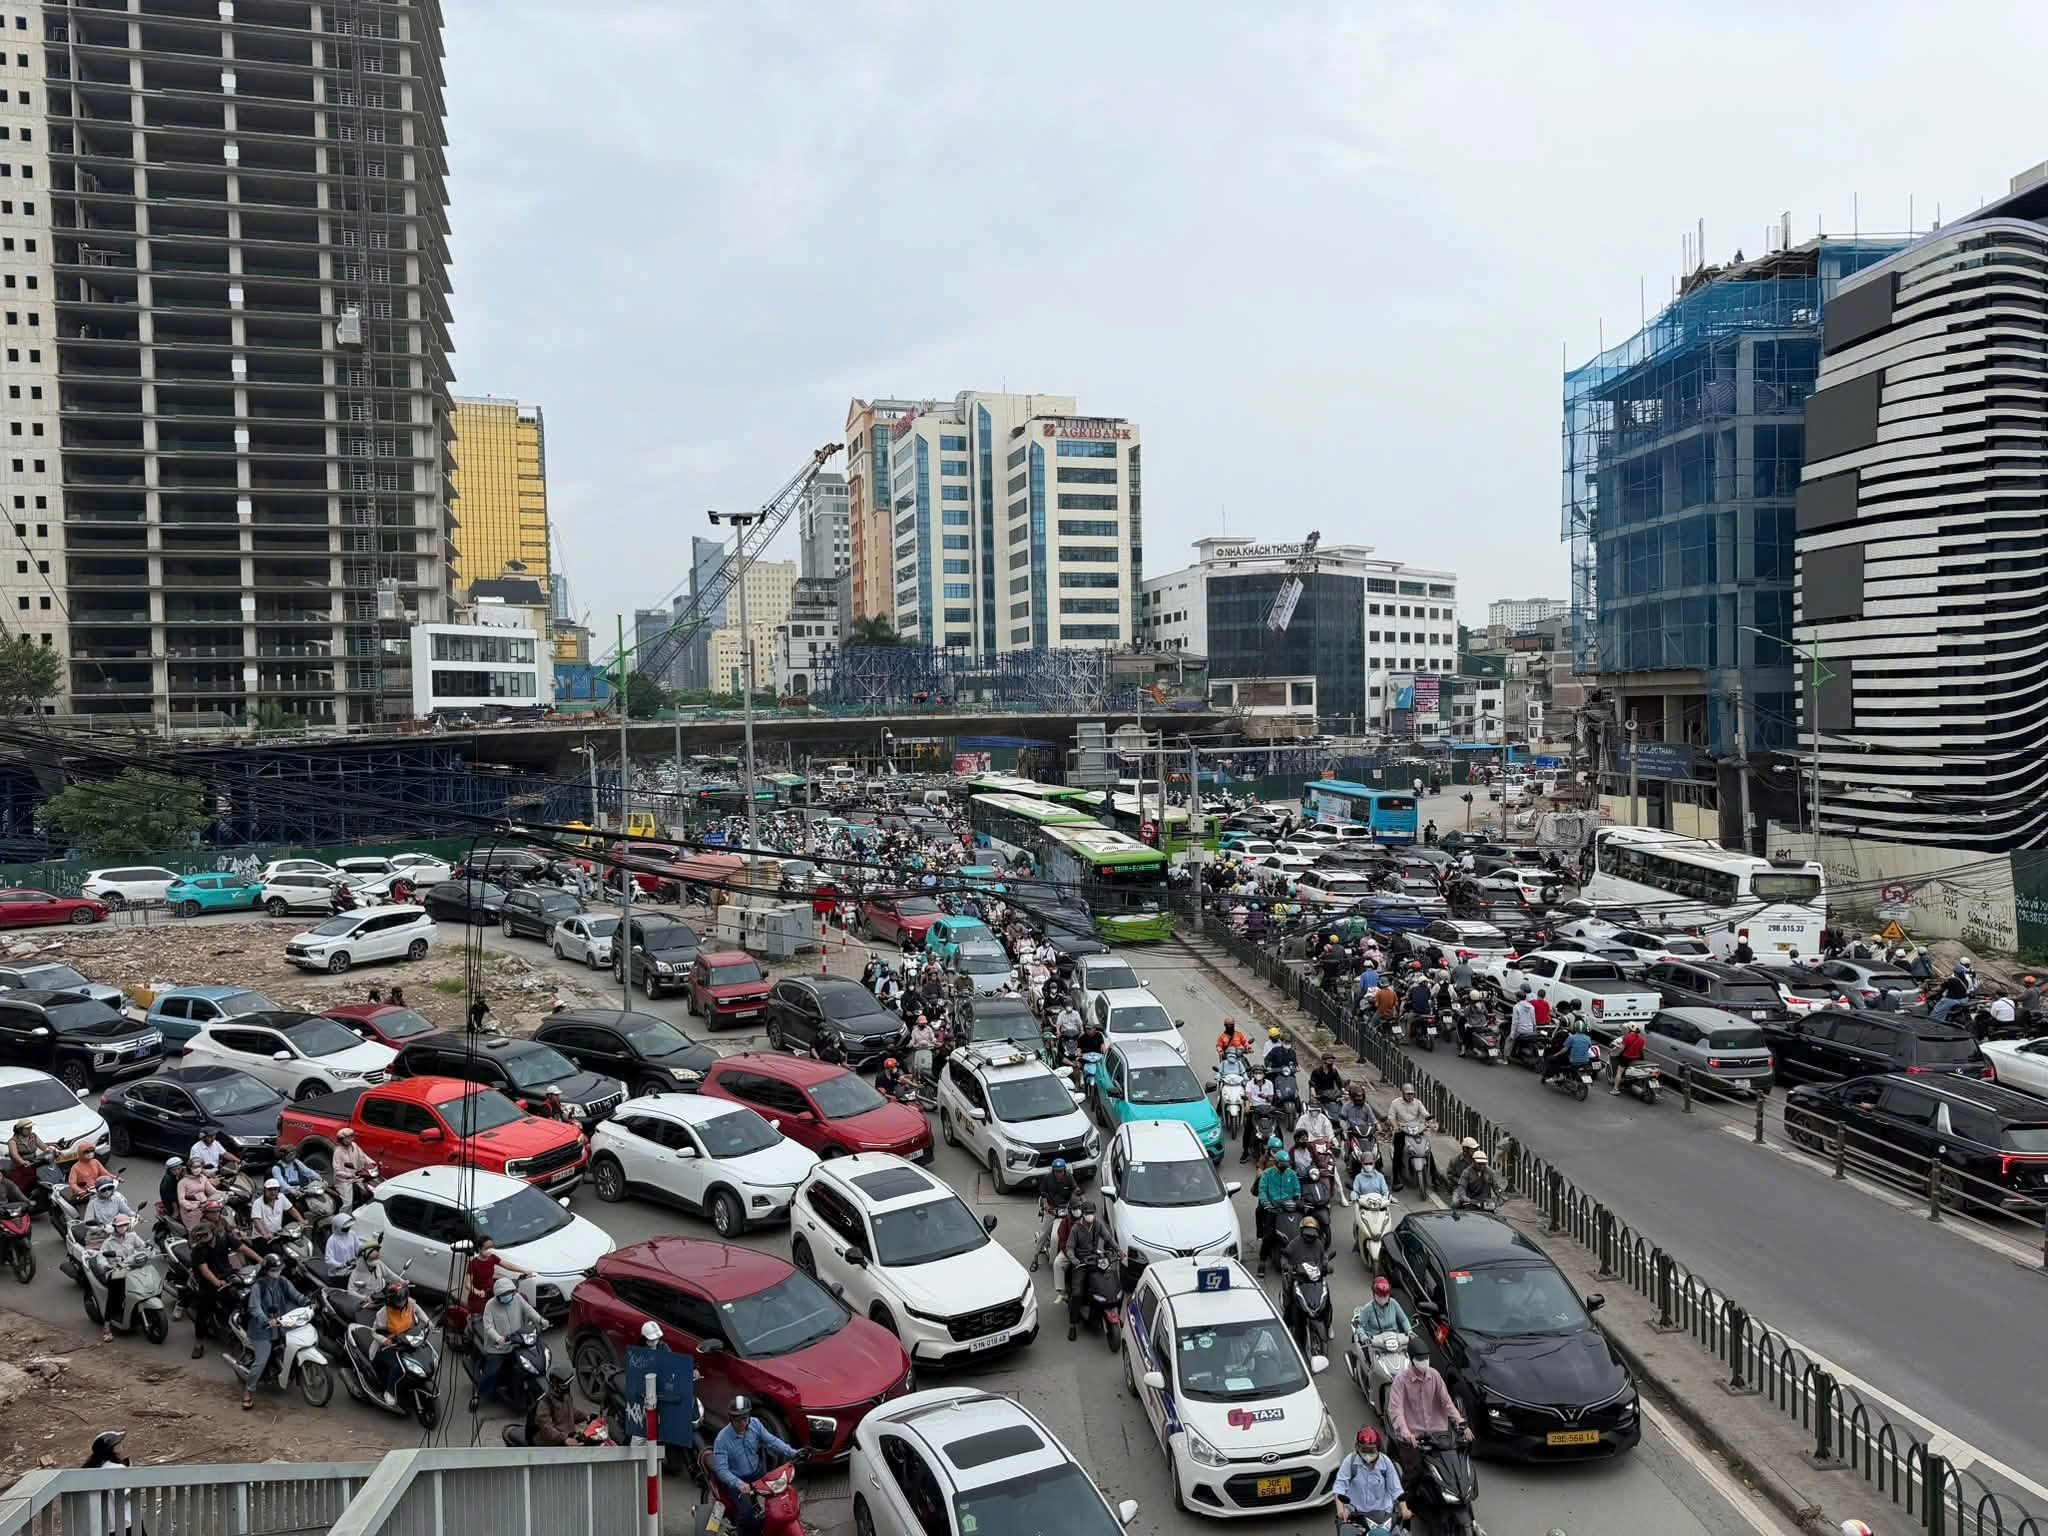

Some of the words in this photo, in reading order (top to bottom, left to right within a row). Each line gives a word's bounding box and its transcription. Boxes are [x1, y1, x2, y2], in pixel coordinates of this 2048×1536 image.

[1060, 427, 1131, 440] AGRIBANK
[1225, 547, 1242, 556] NHÀ
[1243, 545, 1270, 556] KHÁCH
[1272, 543, 1298, 554] THÔNG
[1253, 1408, 1282, 1420] TAXI
